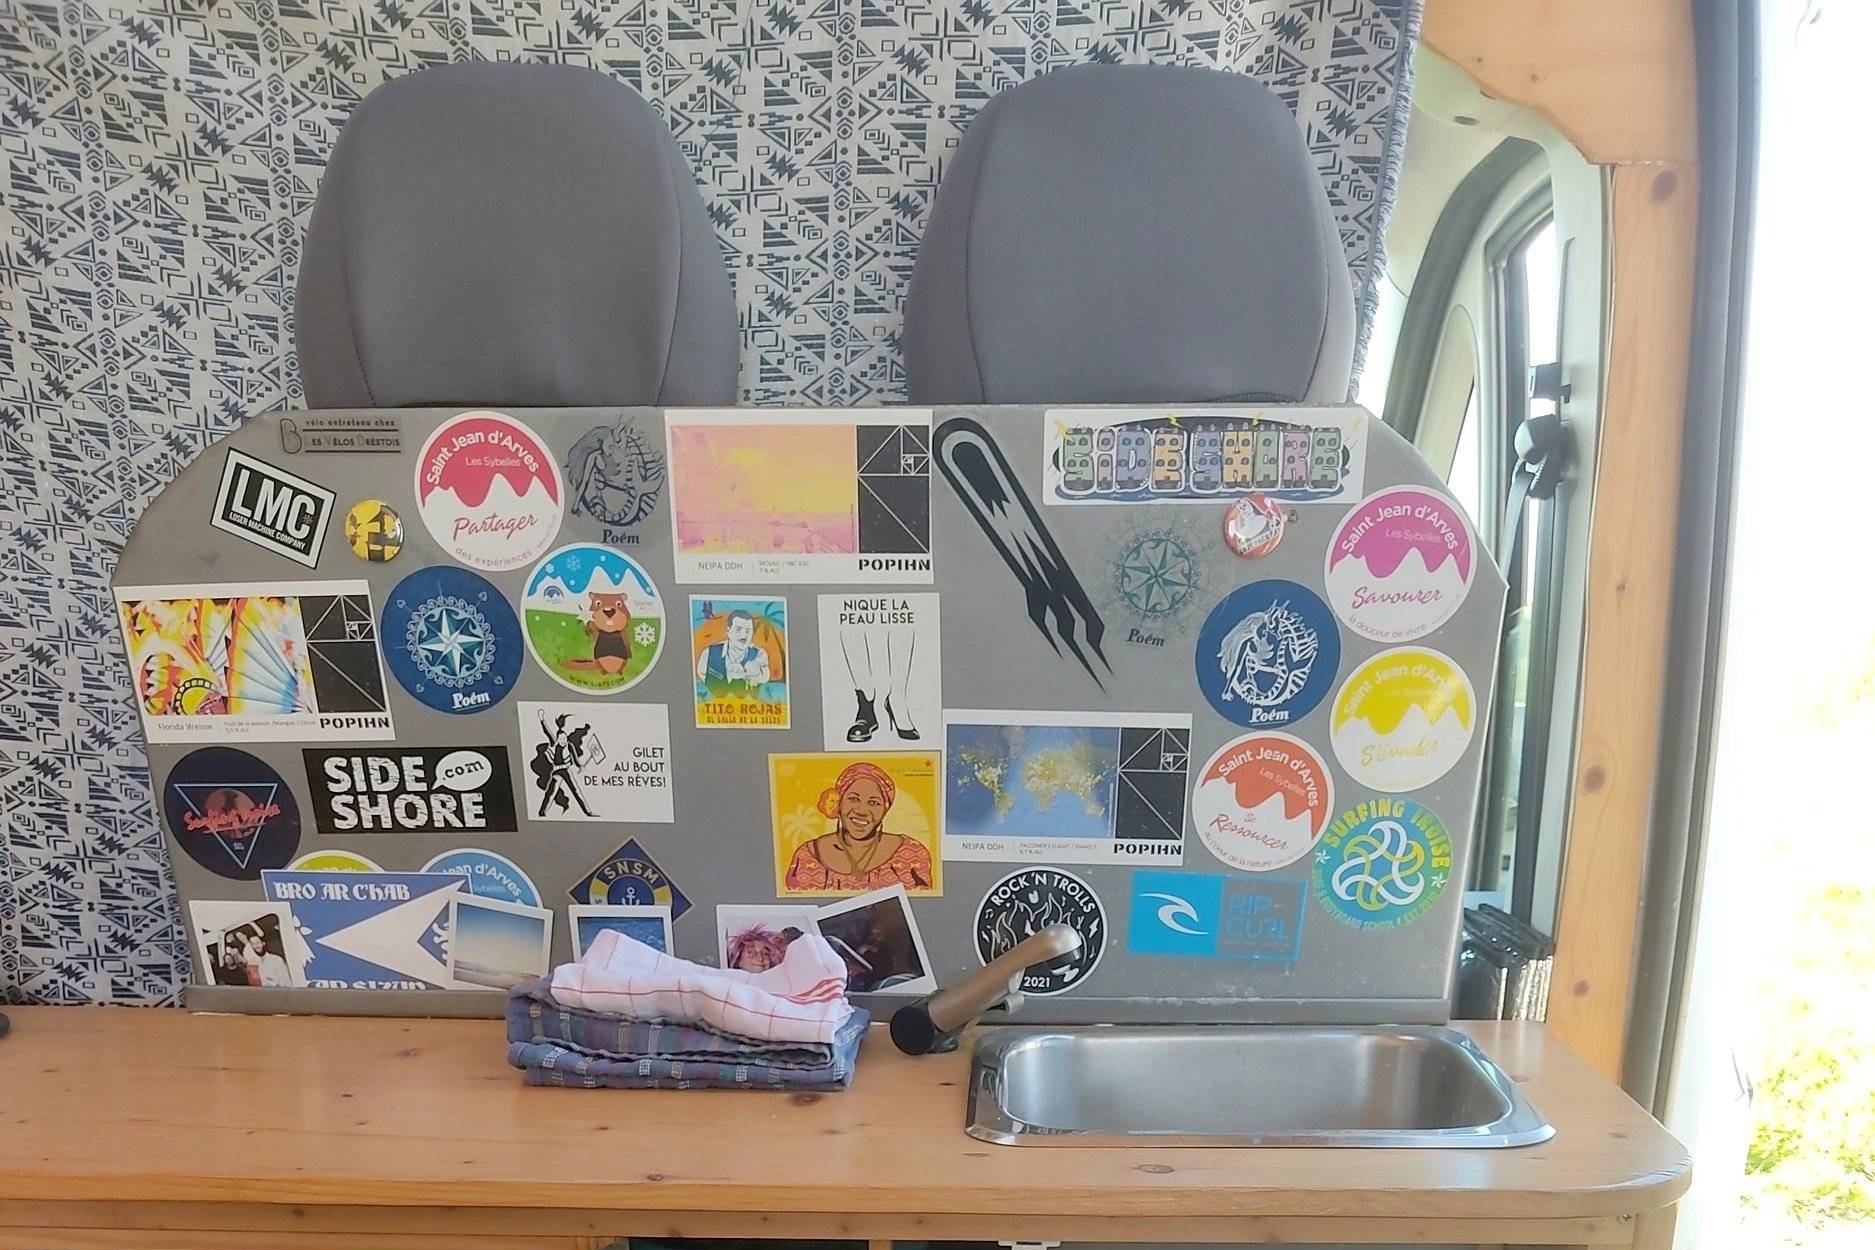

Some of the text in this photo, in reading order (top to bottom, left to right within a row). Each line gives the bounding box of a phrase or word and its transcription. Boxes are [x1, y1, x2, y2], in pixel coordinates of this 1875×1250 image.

[427, 430, 540, 484] Saint Jean d'Arves
[465, 456, 482, 466] Les
[231, 468, 316, 540] LMC
[229, 512, 306, 550] LOSER MACHINE COMPANY
[453, 513, 538, 542] Partager
[1342, 505, 1458, 552] Saint Jean d'Arves
[859, 558, 930, 571] POPIHN
[844, 600, 910, 612] NIQUE LA
[1352, 586, 1442, 609] Savourer
[840, 612, 914, 625] PEAU LISSE
[1344, 680, 1374, 714] Saint
[1376, 665, 1408, 684] Jean
[705, 703, 782, 714] TITO ROJAS
[158, 722, 184, 731] Florida
[320, 717, 390, 729] POPIHN
[633, 747, 664, 758] GILET
[324, 756, 428, 793] SIDE
[442, 760, 486, 781] .com
[614, 762, 665, 772] AU BOUT
[1218, 747, 1320, 807] Saint Jean d'Arves
[584, 776, 598, 786] DE
[602, 776, 624, 786] MES
[331, 793, 487, 830] SHORE
[1209, 813, 1288, 850] Ressourcer
[1322, 798, 1450, 868] SURFING IROISE
[962, 842, 985, 850] NEIPA
[1114, 843, 1182, 856] POPIHN
[443, 862, 522, 896] ean d'Arves
[604, 860, 660, 884] SNSM
[274, 882, 316, 899] BRO
[1054, 874, 1096, 913] TROLLS
[1024, 976, 1050, 988] 2021
